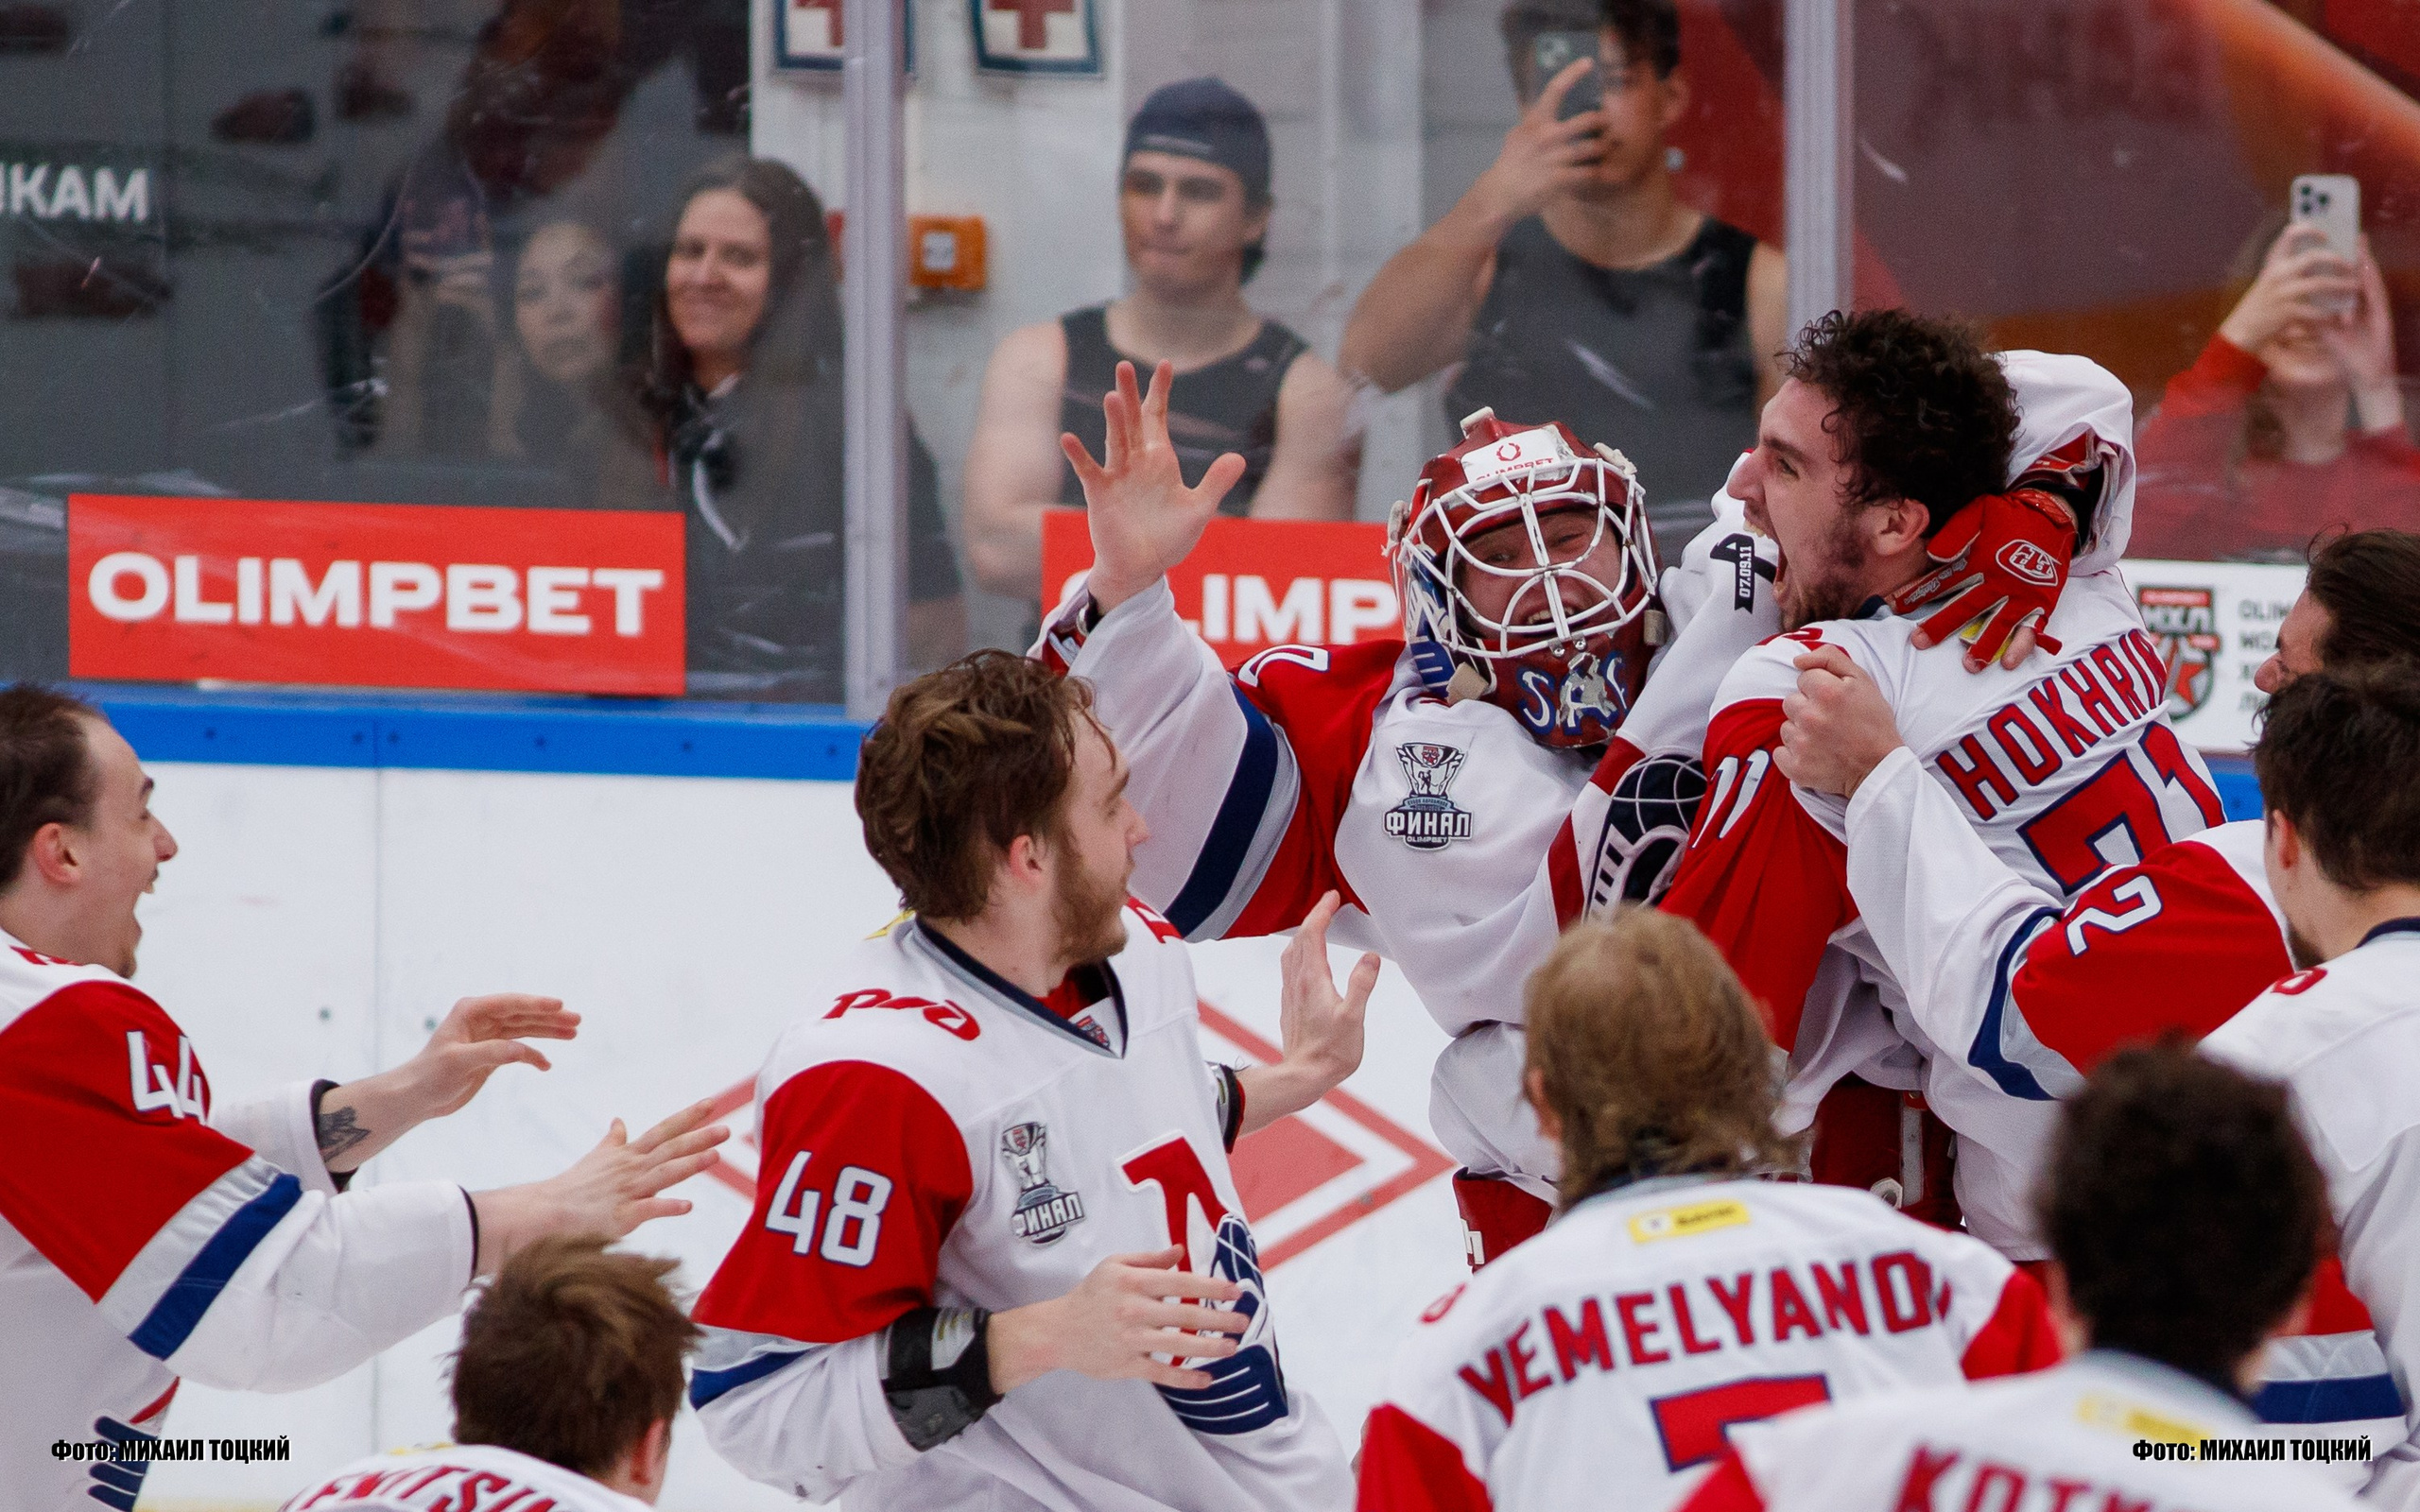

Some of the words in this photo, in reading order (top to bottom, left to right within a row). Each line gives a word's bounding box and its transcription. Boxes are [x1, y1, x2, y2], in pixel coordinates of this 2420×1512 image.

[88, 551, 664, 637] OLIMPBET
[1738, 545, 1753, 598] 07.09.11
[1386, 811, 1471, 837] ФИНАЛ
[2015, 720, 2227, 898] 71
[126, 1028, 206, 1125] 44
[764, 1148, 895, 1269] 48
